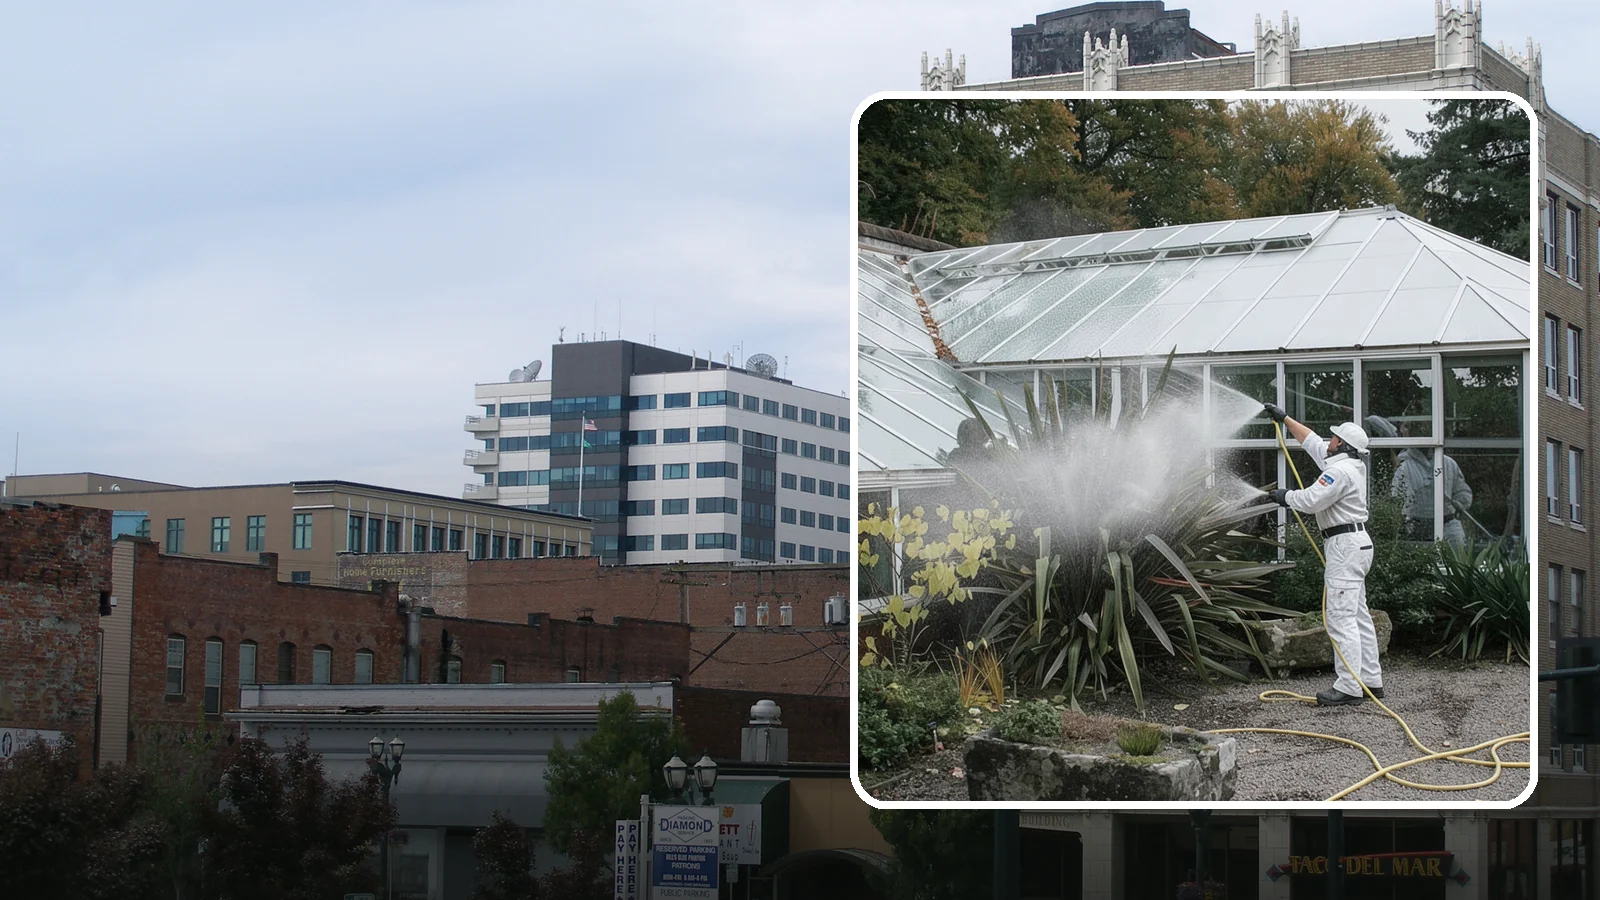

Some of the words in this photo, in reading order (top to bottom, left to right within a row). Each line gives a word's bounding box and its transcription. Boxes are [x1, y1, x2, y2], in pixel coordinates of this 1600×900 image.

[370, 566, 427, 577] Furnishers
[660, 818, 713, 832] DIAMOND
[1022, 816, 1070, 827] BUILDING
[656, 845, 688, 853] RESERVED
[689, 846, 716, 854] PARKING
[722, 851, 739, 862] Soup
[671, 862, 701, 870] PATRONS
[1346, 856, 1385, 875] DEL
[1392, 857, 1444, 876] MAR
[660, 888, 682, 897] PUBLIC
[683, 889, 710, 898] PARKING
